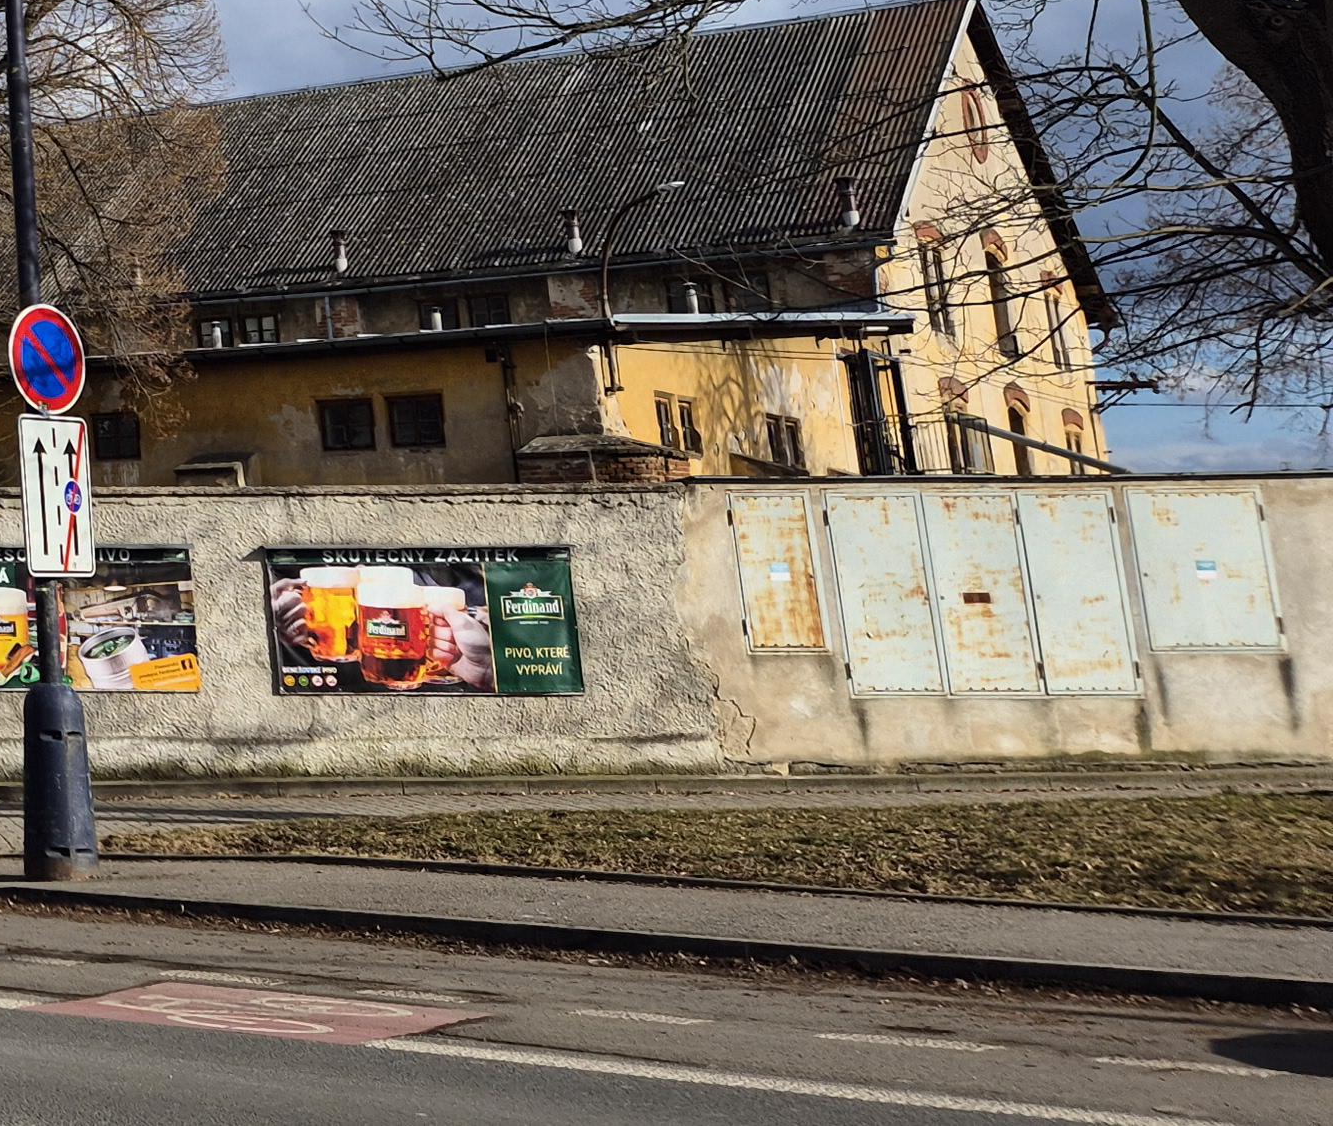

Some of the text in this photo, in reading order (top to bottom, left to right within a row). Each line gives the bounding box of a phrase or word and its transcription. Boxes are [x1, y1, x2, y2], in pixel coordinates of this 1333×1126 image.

[99, 549, 130, 562] IVO
[504, 599, 560, 614] Ferdinand
[505, 644, 570, 660] PIVO, KTERÉ
[515, 661, 563, 675] VYPRÁVÍ
